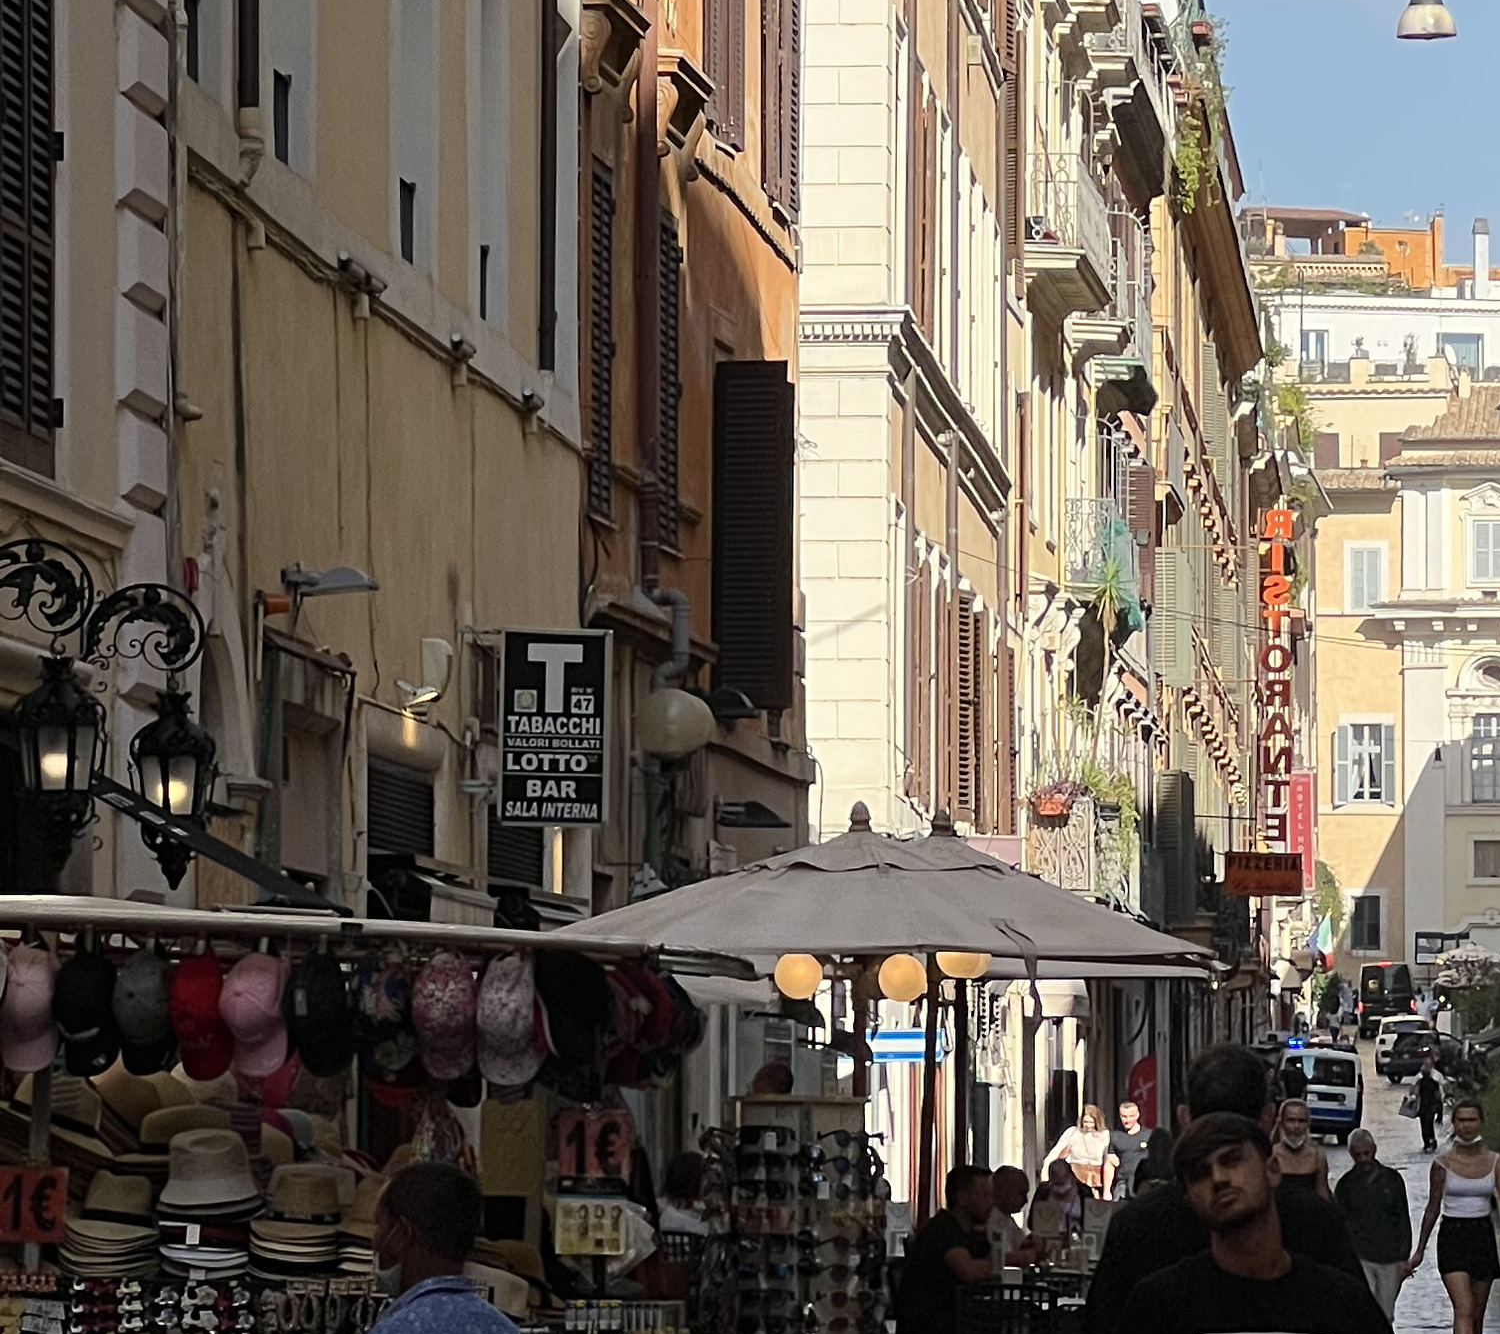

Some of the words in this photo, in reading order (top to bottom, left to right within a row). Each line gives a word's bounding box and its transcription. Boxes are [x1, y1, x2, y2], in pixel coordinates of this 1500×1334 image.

[527, 643, 584, 713] T
[573, 697, 592, 711] 47
[507, 715, 601, 735] TABACCHI
[507, 737, 549, 748] VALORI
[552, 738, 600, 749] BOLLATI
[506, 752, 588, 772] LOTTO
[526, 779, 577, 799] BAR
[505, 800, 539, 818] SALA
[541, 801, 598, 820] INTERNA
[2, 1173, 57, 1232] 1€
